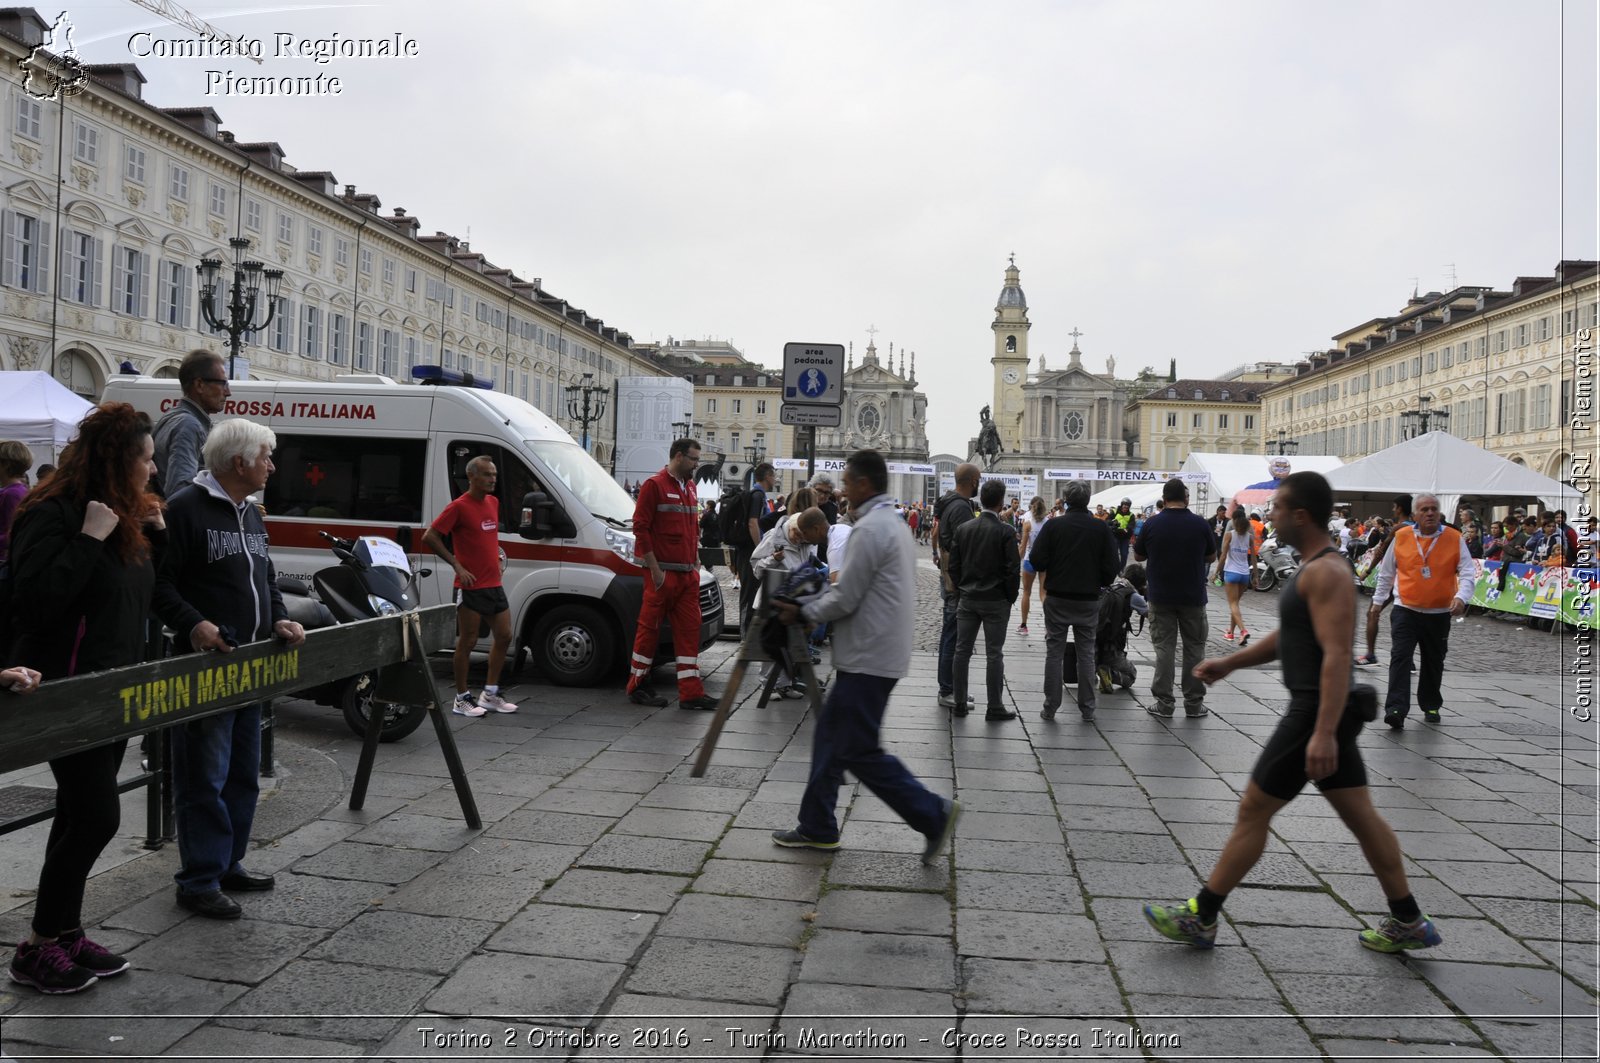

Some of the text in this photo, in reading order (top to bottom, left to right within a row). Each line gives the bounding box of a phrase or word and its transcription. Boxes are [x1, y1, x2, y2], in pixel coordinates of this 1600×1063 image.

[794, 357, 834, 365] pedonale
[224, 400, 285, 417] ROSSA
[290, 402, 377, 420] ITALIANA
[1097, 470, 1156, 481] PARTENZA
[119, 649, 299, 724] TURIN MARATHON
